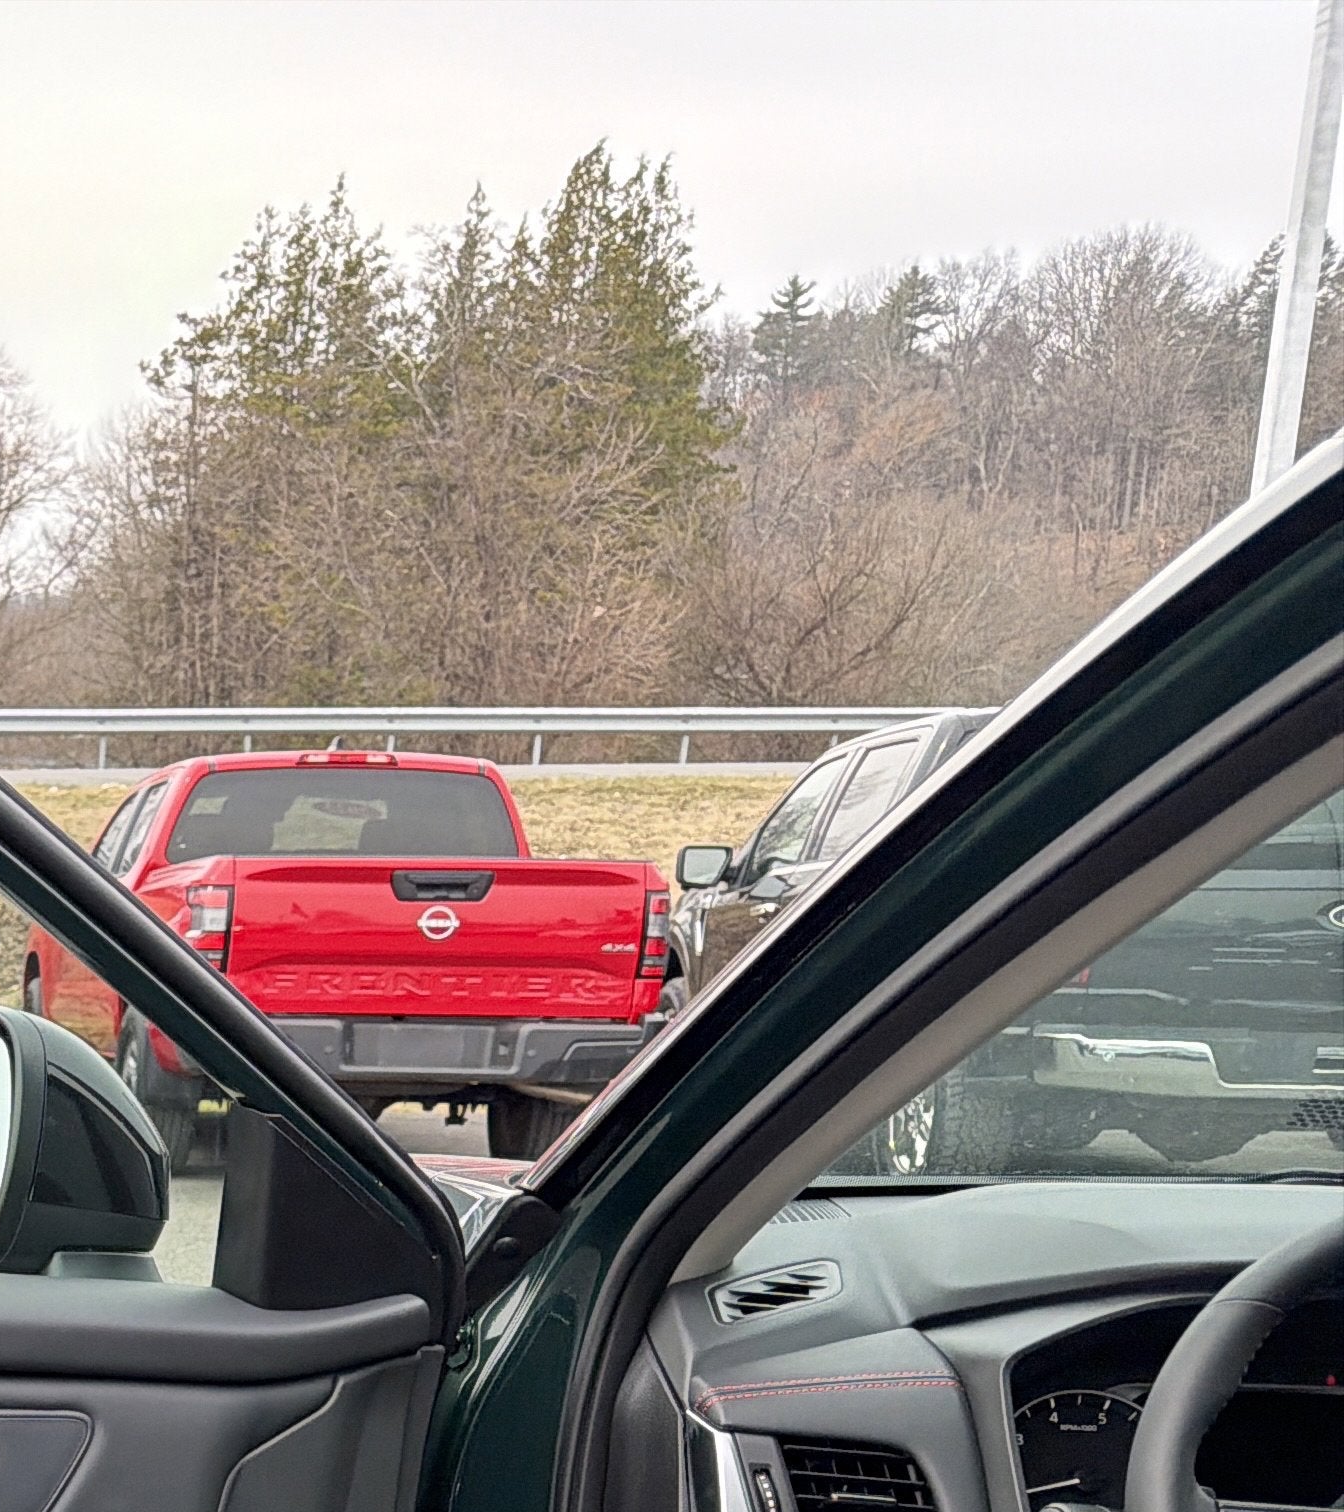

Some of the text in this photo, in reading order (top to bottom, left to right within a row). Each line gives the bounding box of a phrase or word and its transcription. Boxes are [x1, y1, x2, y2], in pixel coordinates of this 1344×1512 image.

[260, 970, 615, 1000] FRONTIER
[1049, 1411, 1059, 1423] 4
[1097, 1412, 1107, 1425] 5
